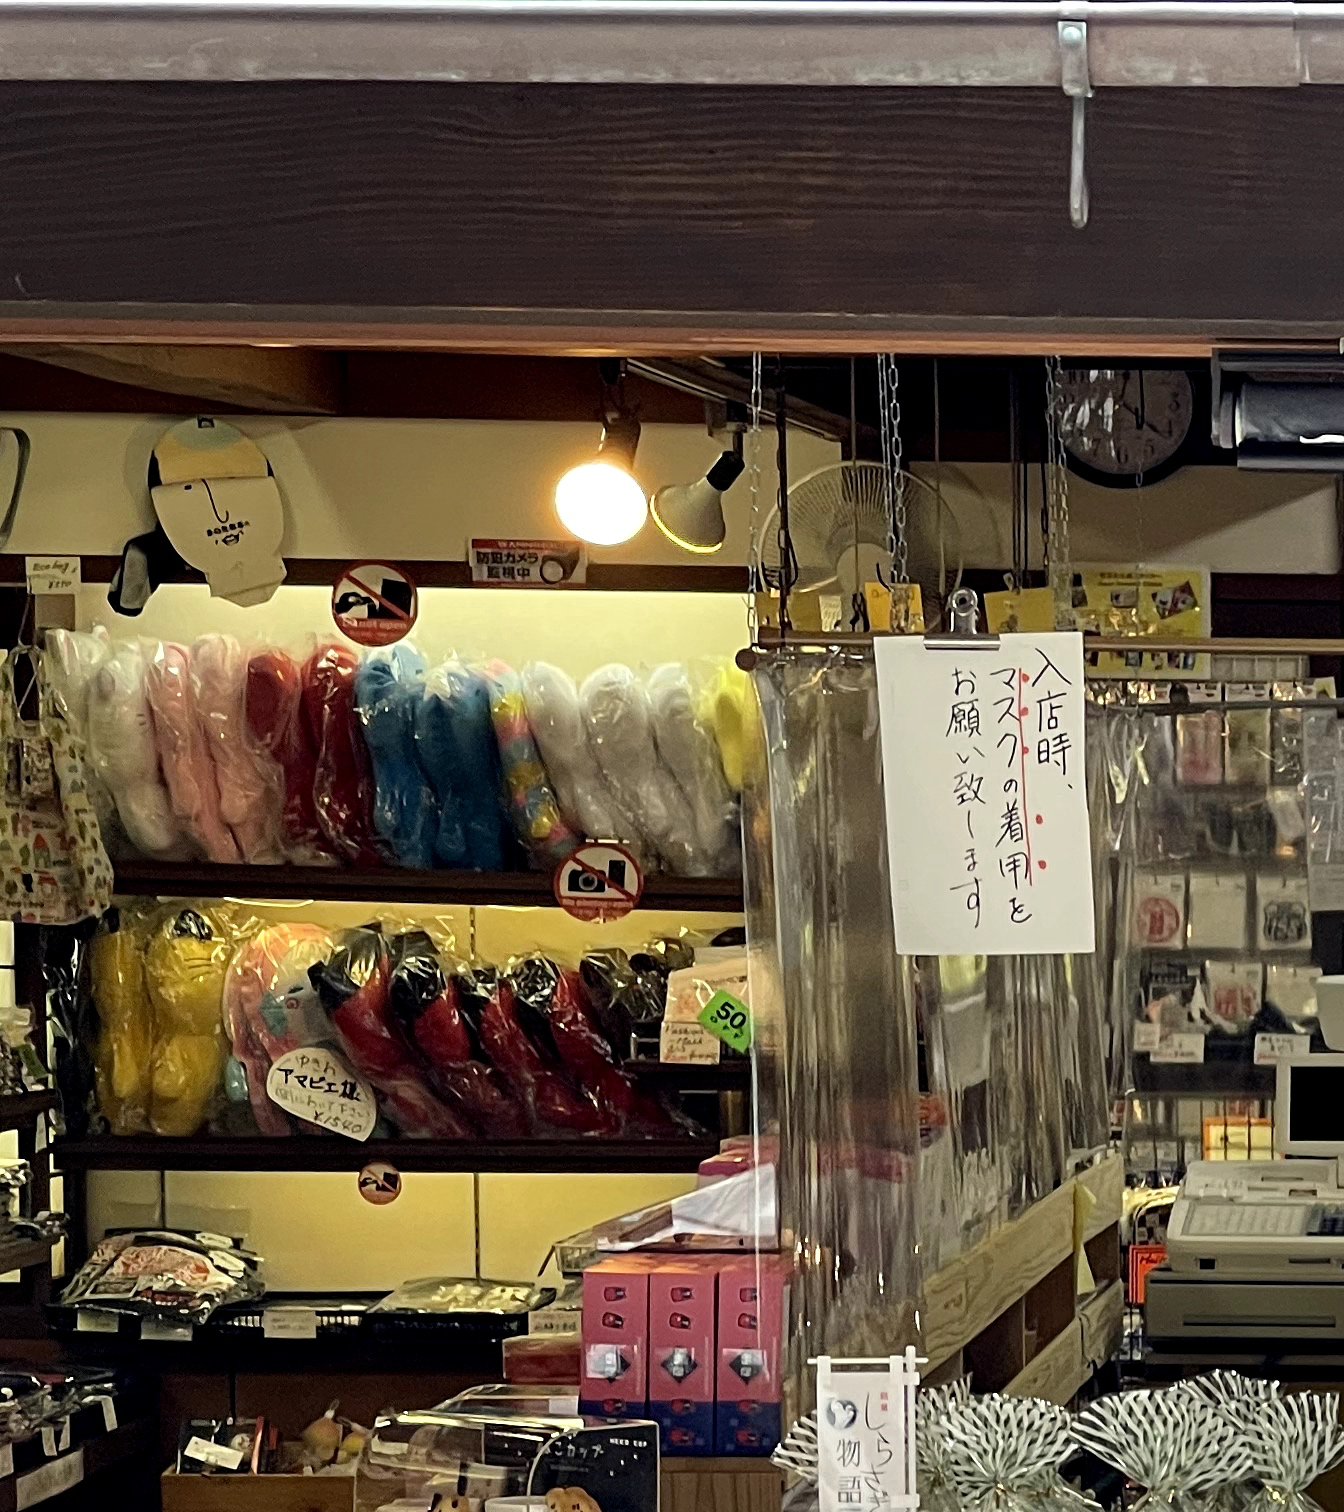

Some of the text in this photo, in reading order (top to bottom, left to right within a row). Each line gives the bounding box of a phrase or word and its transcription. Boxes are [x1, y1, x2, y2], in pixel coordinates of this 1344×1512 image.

[945, 666, 986, 929] お願い致します
[991, 665, 1033, 924] マスクの着用を
